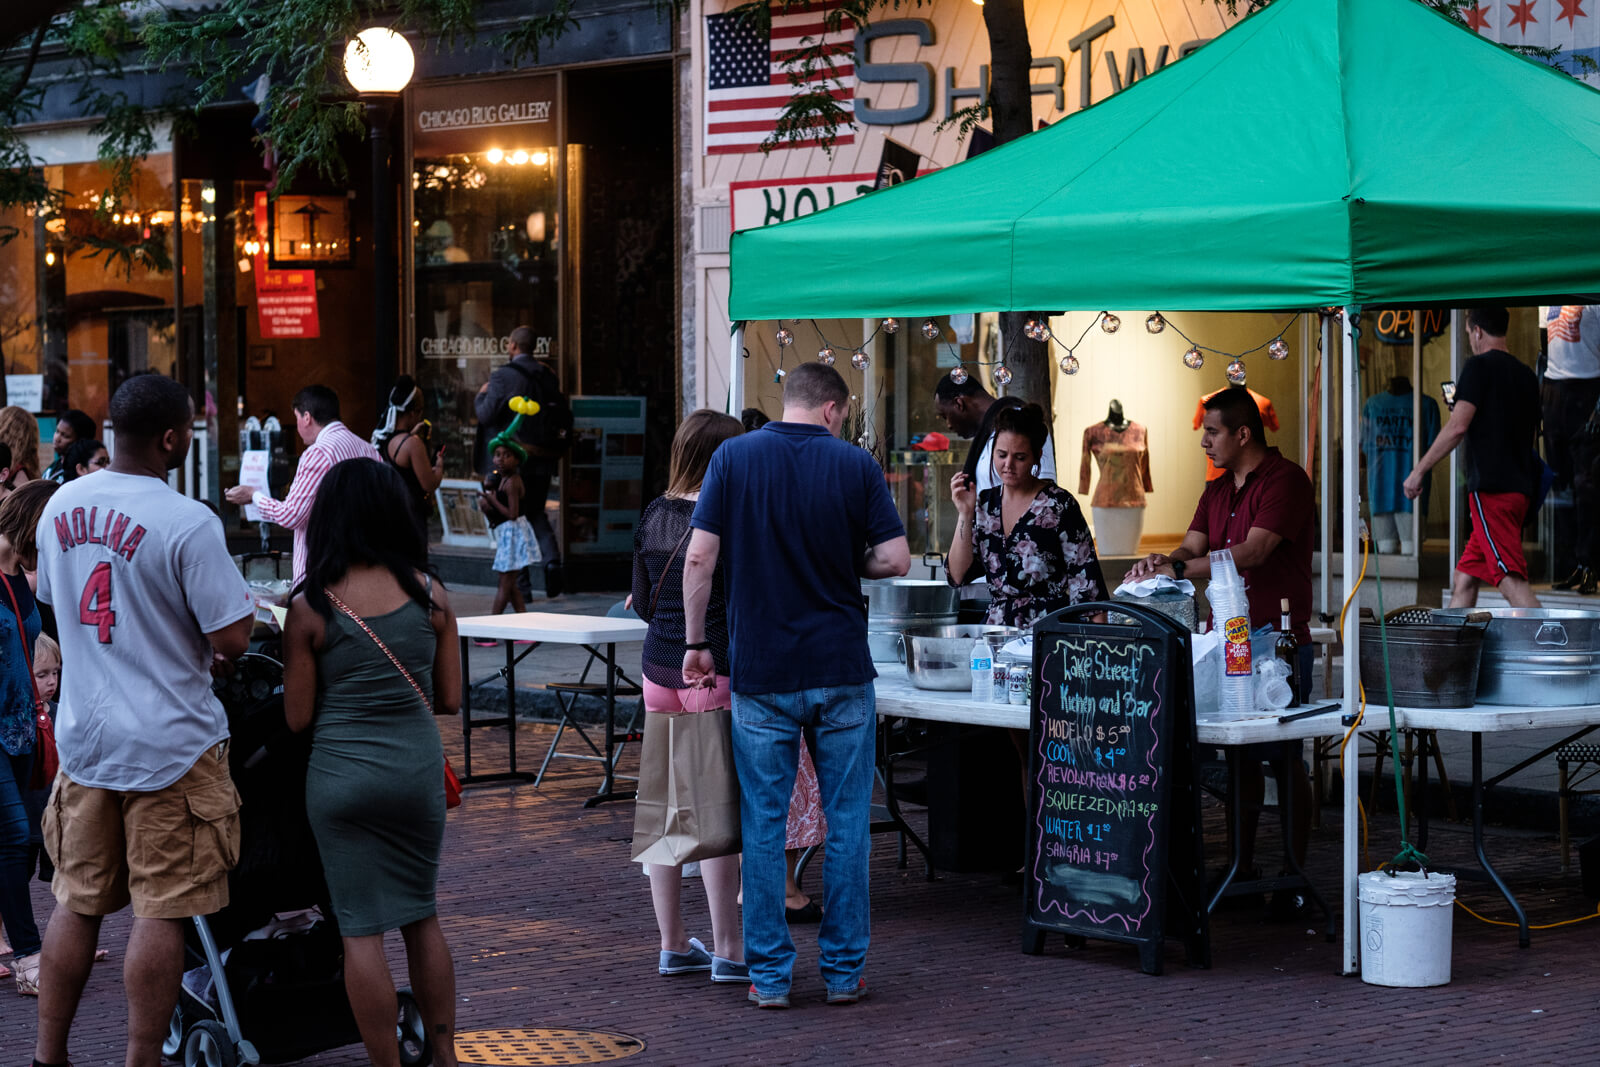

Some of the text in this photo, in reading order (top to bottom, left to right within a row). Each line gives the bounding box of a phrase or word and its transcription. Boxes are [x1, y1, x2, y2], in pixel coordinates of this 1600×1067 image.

[419, 101, 551, 129] CHICAGO RUG GALLERY
[421, 336, 471, 355] CHICAGO
[473, 336, 497, 355] RUG
[54, 506, 147, 562] MOLINA
[80, 561, 116, 644] 4
[1063, 647, 1092, 680] Lake
[1099, 690, 1120, 716] and
[1123, 692, 1152, 718] Bar
[1048, 718, 1092, 741] MODELO
[1046, 789, 1115, 815] SQUEEZED
[1046, 815, 1083, 842] WATER
[1046, 842, 1091, 864] SANGRIA
